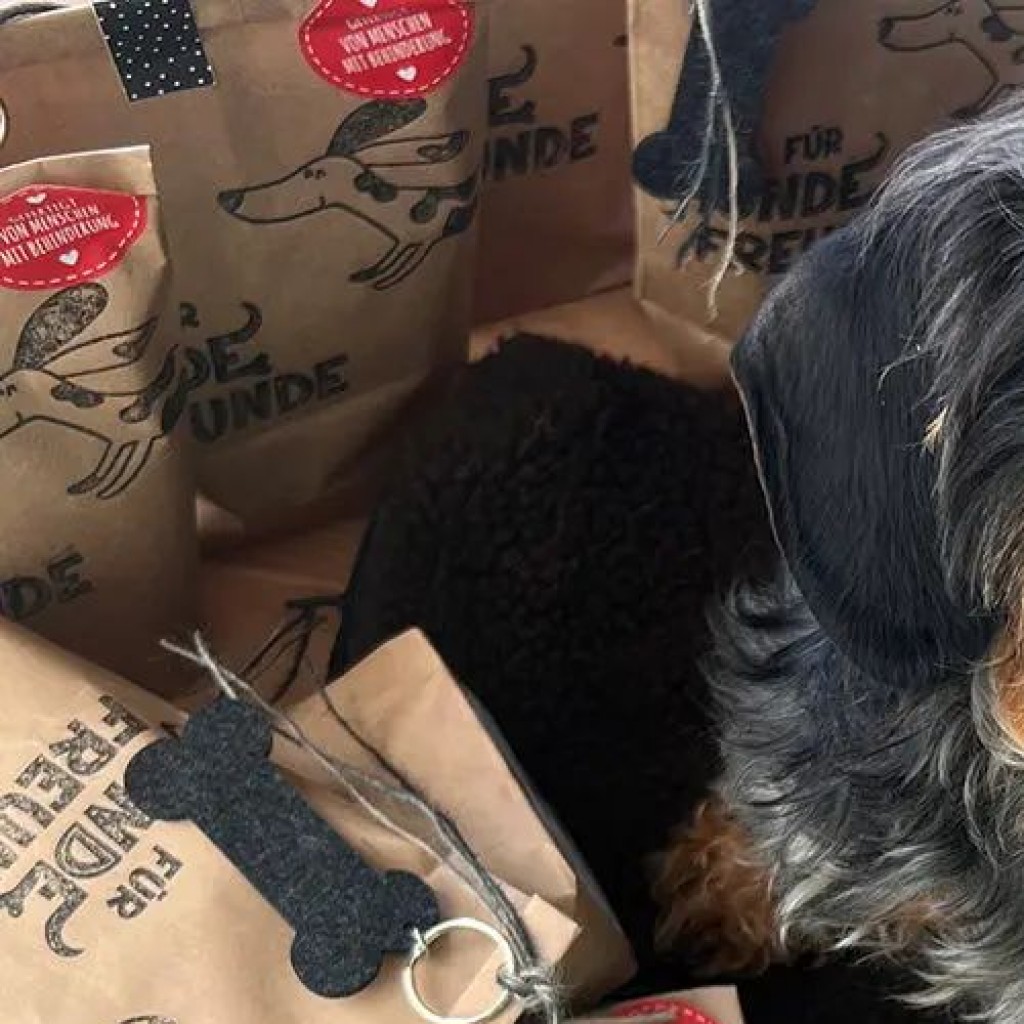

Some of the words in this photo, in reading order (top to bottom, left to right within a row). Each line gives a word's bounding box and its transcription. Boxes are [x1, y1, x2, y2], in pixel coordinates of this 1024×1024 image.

[785, 125, 843, 164] FÜR
[190, 354, 350, 442] UNDE
[0, 695, 151, 869] FREU
[0, 782, 151, 957] NDE
[106, 844, 183, 919] FÜR
